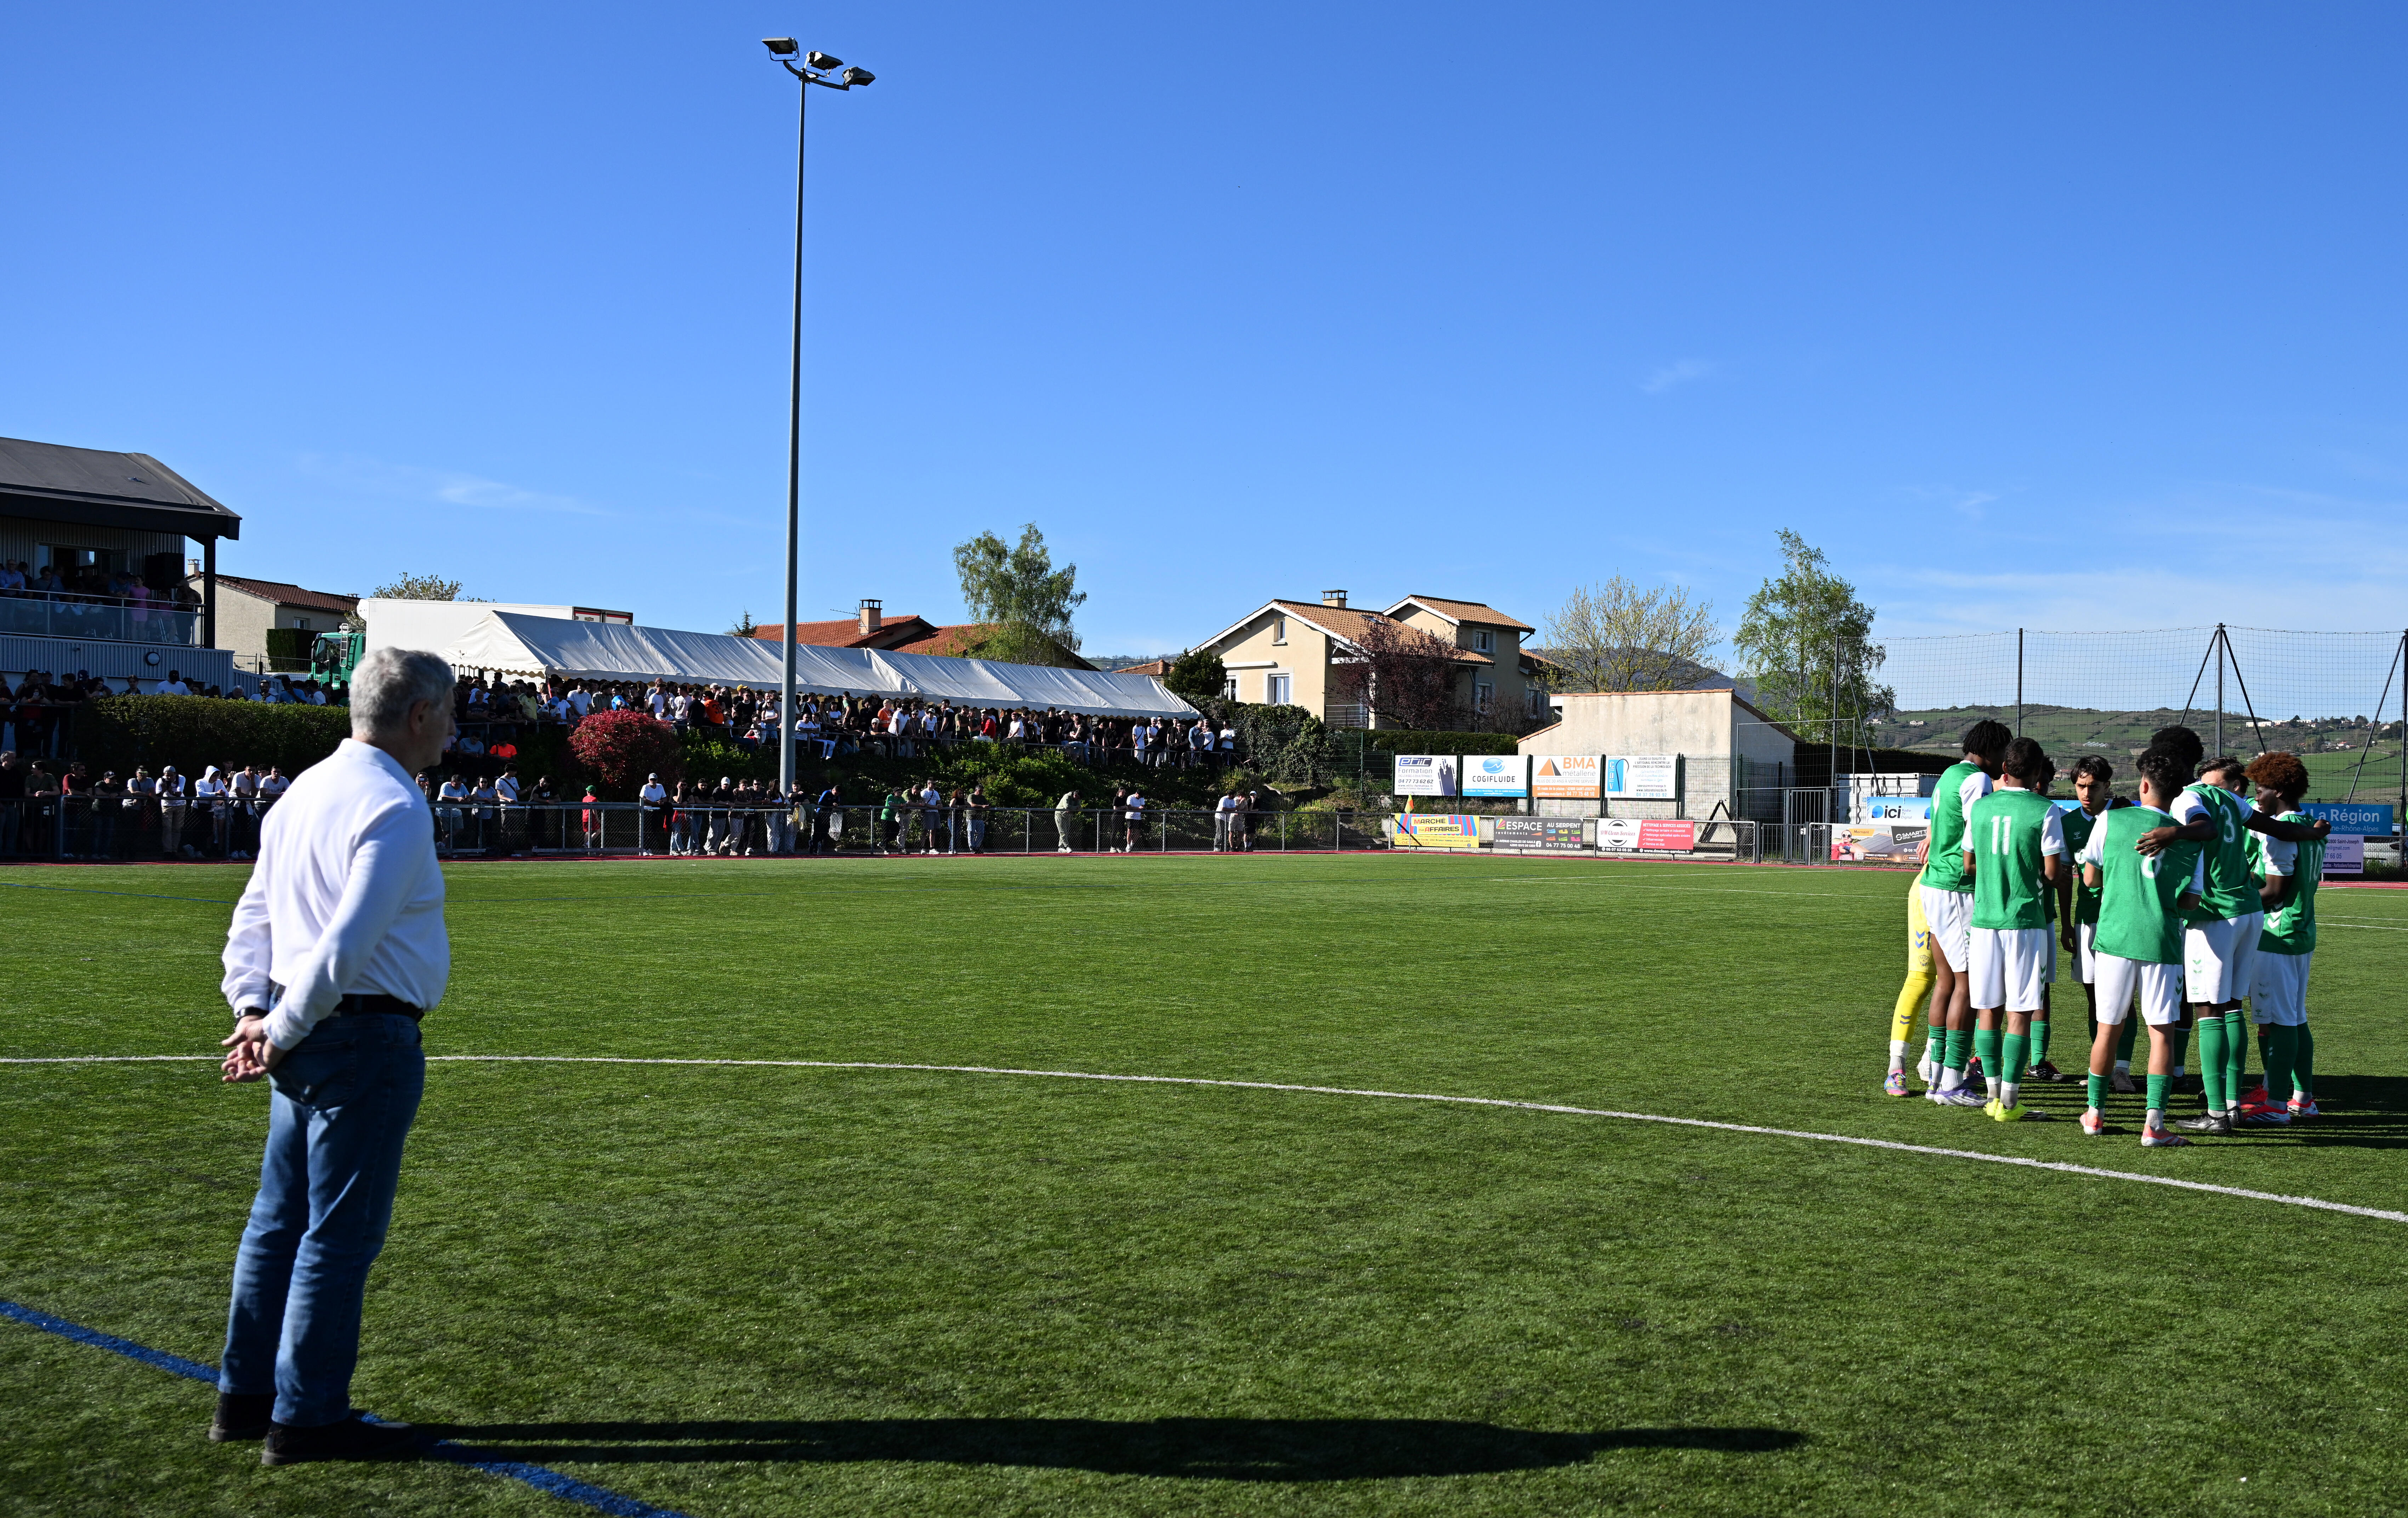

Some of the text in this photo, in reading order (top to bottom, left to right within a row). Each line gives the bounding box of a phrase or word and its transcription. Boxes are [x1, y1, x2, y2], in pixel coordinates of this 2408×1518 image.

[1563, 757, 1596, 769] BMA
[1884, 805, 1901, 818] ici
[2330, 809, 2379, 824] Région
[1506, 821, 1542, 831] ESPACE
[2220, 804, 2236, 843] 3
[1991, 816, 2011, 855] 11
[2310, 845, 2322, 882] 10
